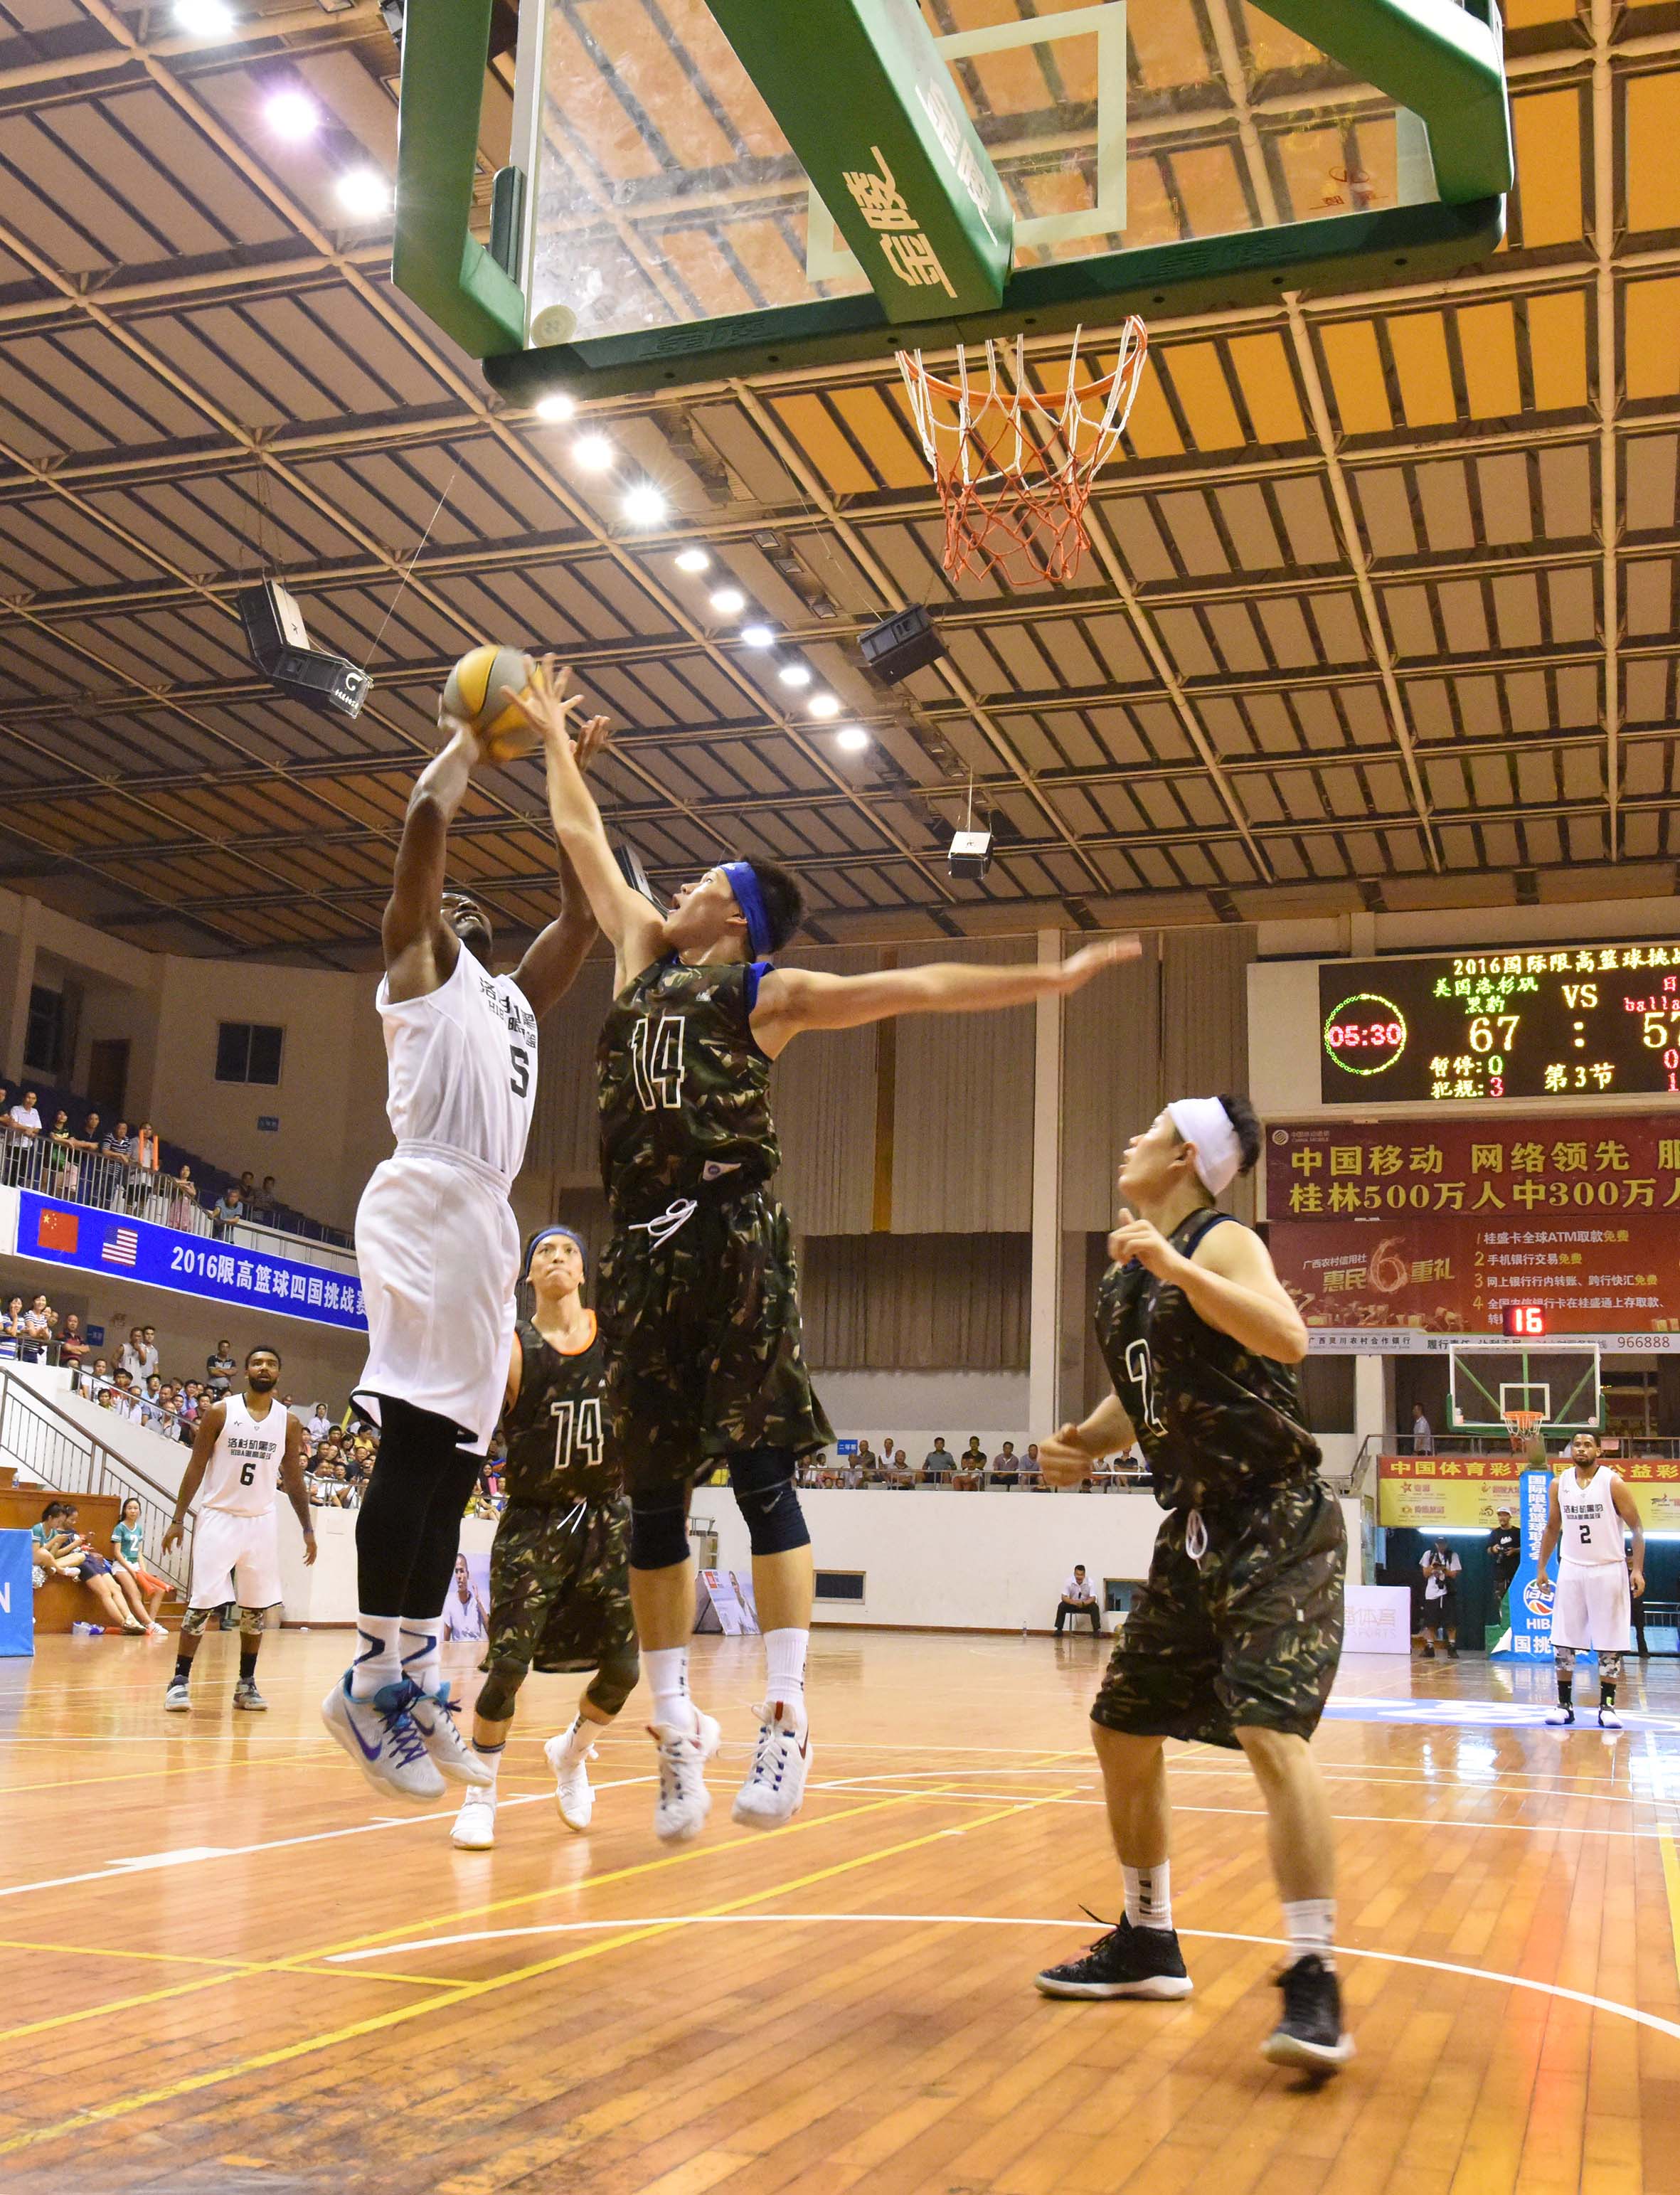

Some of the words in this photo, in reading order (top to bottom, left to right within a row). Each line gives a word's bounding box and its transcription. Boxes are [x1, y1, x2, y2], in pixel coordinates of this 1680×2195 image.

[1432, 976, 1539, 997] 美国洛杉矶
[1561, 983, 1598, 1009] VS
[1464, 995, 1506, 1014] 黑豹
[1328, 1022, 1402, 1048] 05:30
[1468, 1015, 1521, 1053] 67
[509, 1043, 530, 1099] 5
[630, 1015, 686, 1112] 14
[1544, 1062, 1615, 1092] 第3节
[1291, 1144, 1444, 1177] 中国移动
[1471, 1139, 1630, 1174] 网络领先
[1484, 1229, 1630, 1245] 桂盛卡全球ATM取款免费
[1302, 1253, 1368, 1270] 广西农村信用社
[1474, 1251, 1485, 1267] 2
[1487, 1252, 1583, 1266] 手机银行交易免费
[1474, 1272, 1484, 1289] 3
[1472, 1295, 1484, 1311] 4
[1514, 1307, 1543, 1334] 16
[1617, 1336, 1671, 1349] 966888
[228, 1437, 277, 1453] 洛杉矶黑豹
[240, 1462, 256, 1487] 6
[129, 1534, 139, 1552] 2
[1579, 1524, 1592, 1544] 2
[1526, 1617, 1551, 1630] HIB
